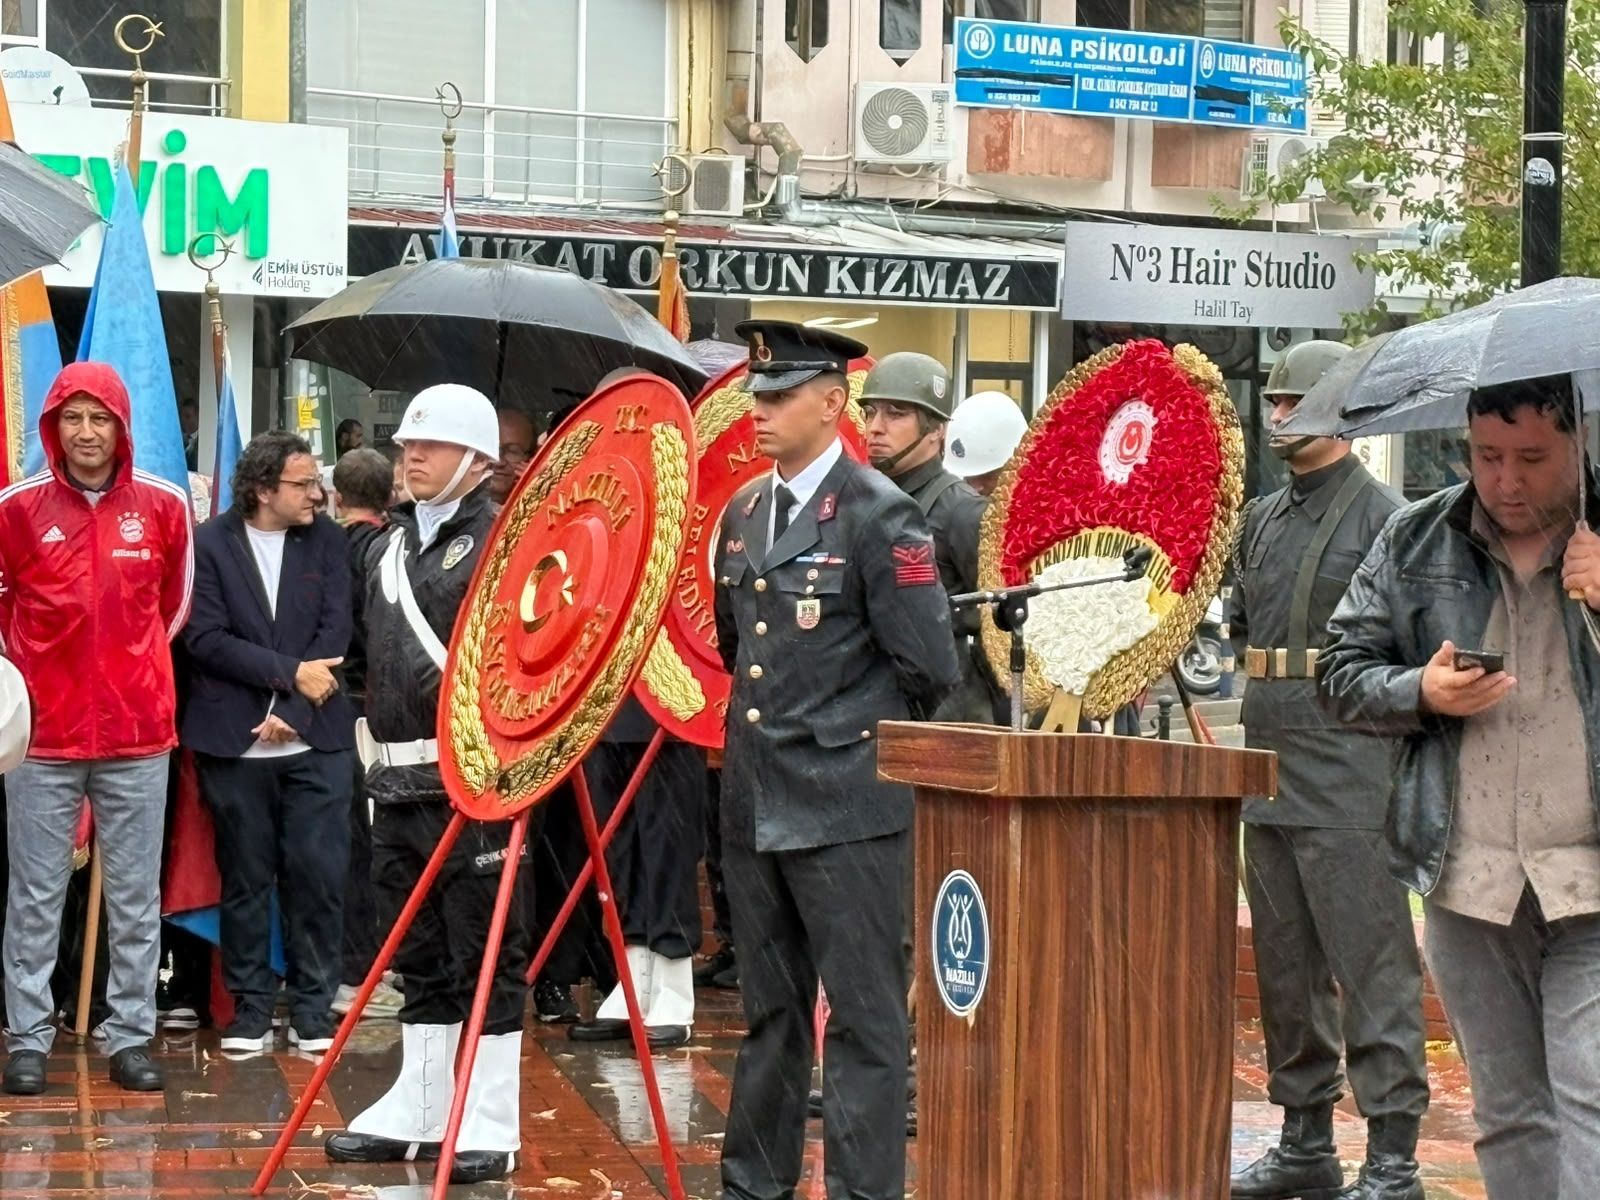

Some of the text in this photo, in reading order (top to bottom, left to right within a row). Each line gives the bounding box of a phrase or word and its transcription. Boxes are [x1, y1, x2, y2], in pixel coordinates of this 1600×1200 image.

[1003, 32, 1185, 67] LUNA PSİKOLOJİ
[1218, 52, 1247, 74] LUNA
[31, 128, 269, 260] VİM
[268, 259, 344, 276] EMİN ÜSTÜN
[629, 244, 814, 294] ORKUN
[824, 255, 1012, 301] KIZMAZ
[1169, 246, 1237, 286] Hair
[1244, 250, 1336, 290] Studio
[268, 275, 311, 292] Holding
[1194, 299, 1254, 324] Halil Tay
